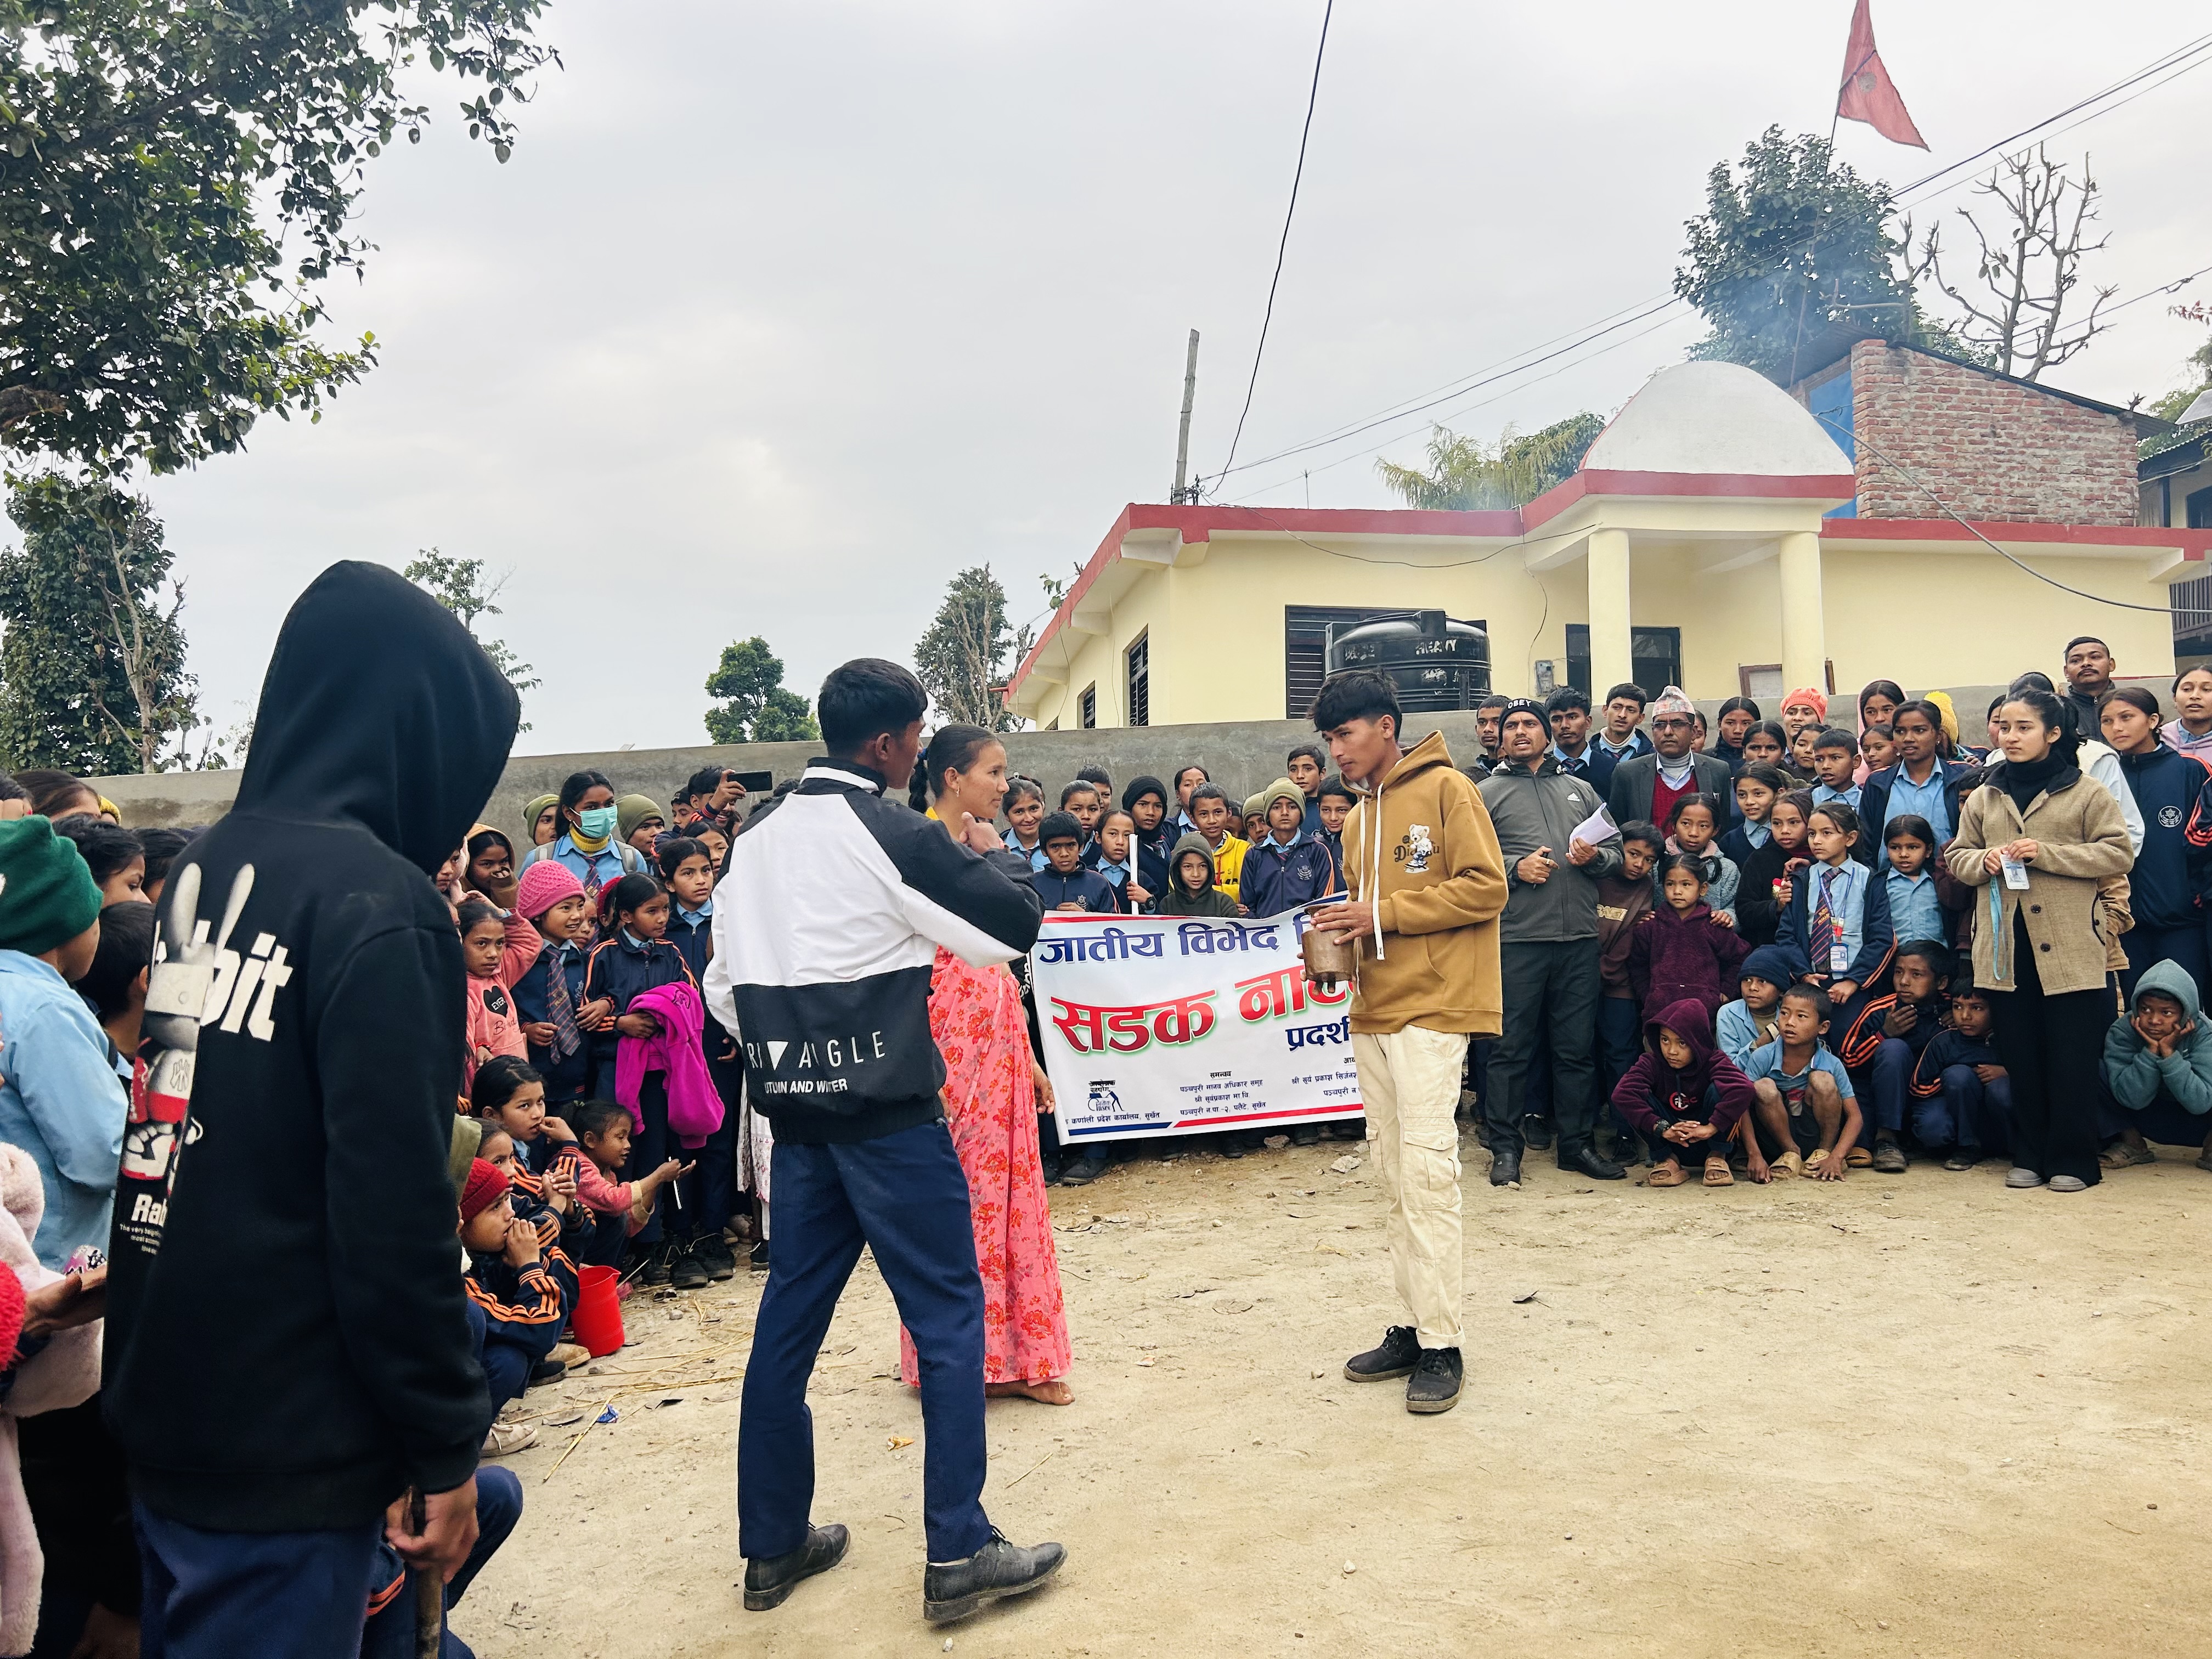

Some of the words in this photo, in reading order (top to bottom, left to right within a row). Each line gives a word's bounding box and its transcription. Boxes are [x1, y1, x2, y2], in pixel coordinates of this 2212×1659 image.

[1508, 699, 1532, 709] OBEY
[1037, 927, 1165, 963] जातीय
[1177, 921, 1280, 956] विभेद
[1050, 990, 1216, 1053] सडक
[1285, 1015, 1350, 1052] प्रदर्श
[1314, 1074, 1333, 1082] प्रकाश
[789, 1080, 814, 1094] AND
[1071, 1115, 1094, 1125] कर्णाली
[1097, 1114, 1111, 1123] प्रदेश
